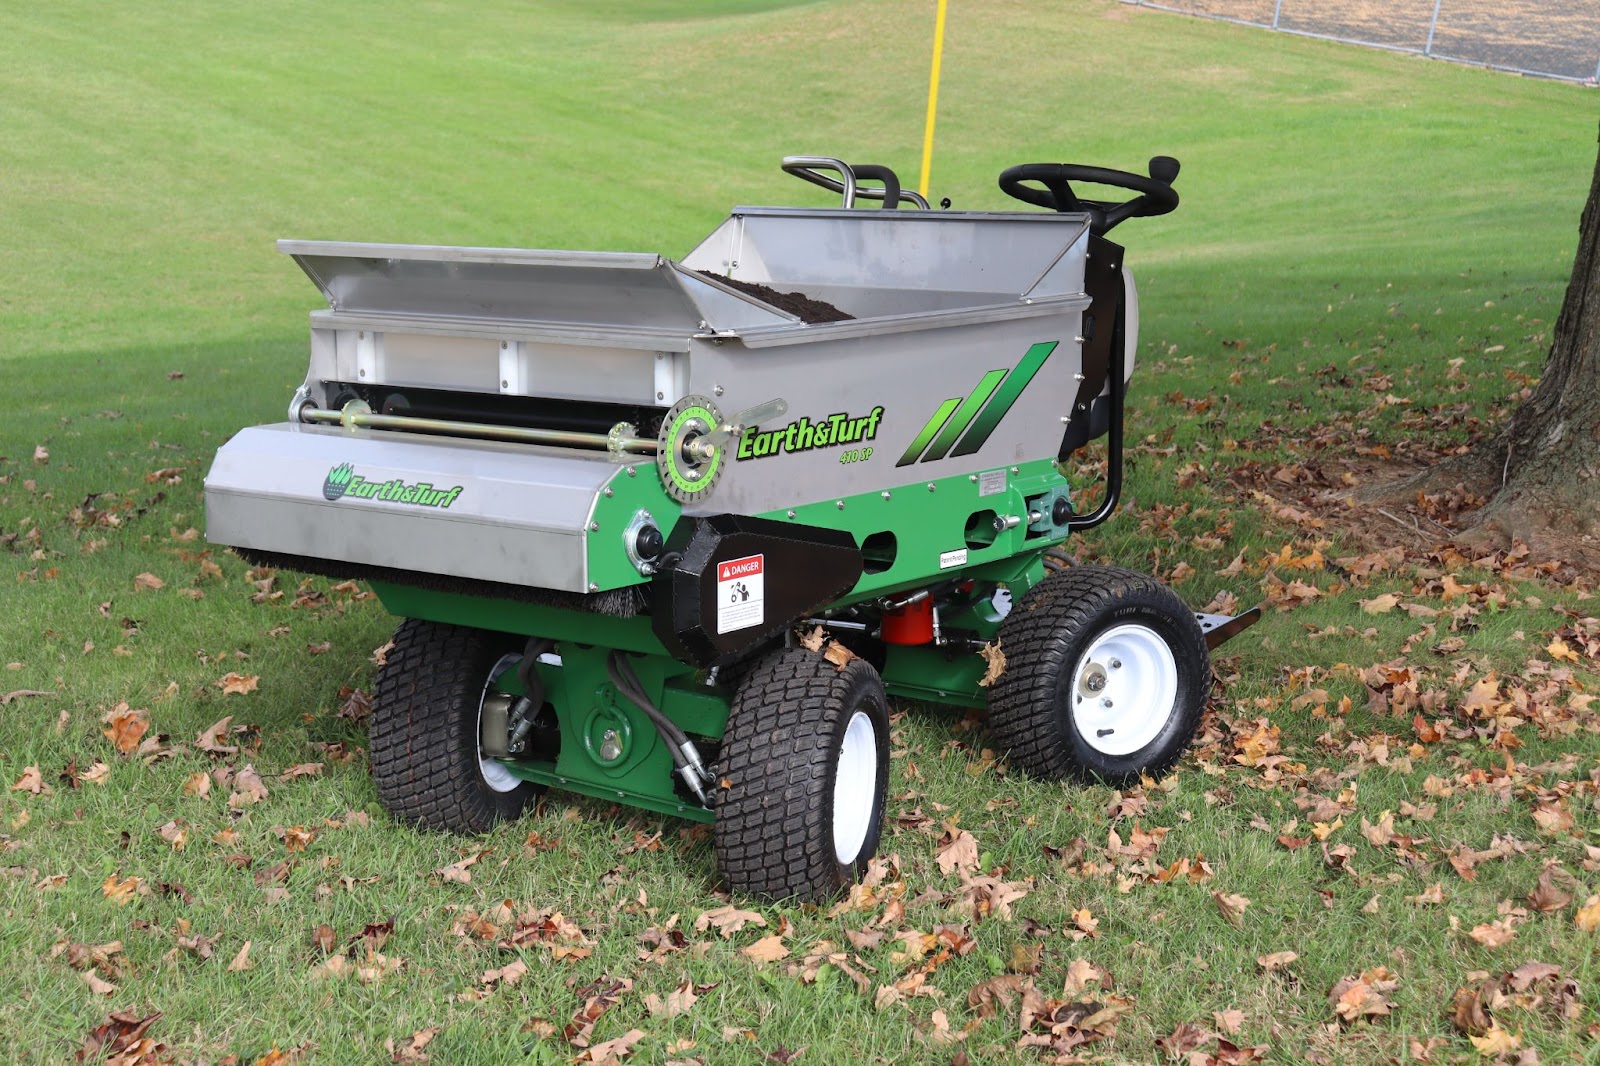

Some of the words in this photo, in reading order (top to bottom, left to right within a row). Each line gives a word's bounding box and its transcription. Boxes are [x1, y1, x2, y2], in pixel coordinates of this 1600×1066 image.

[736, 405, 885, 462] Earth&Turf
[839, 449, 859, 464] 410
[860, 447, 873, 462] SP
[343, 475, 464, 508] Earth&Turf
[731, 561, 759, 575] DANGER
